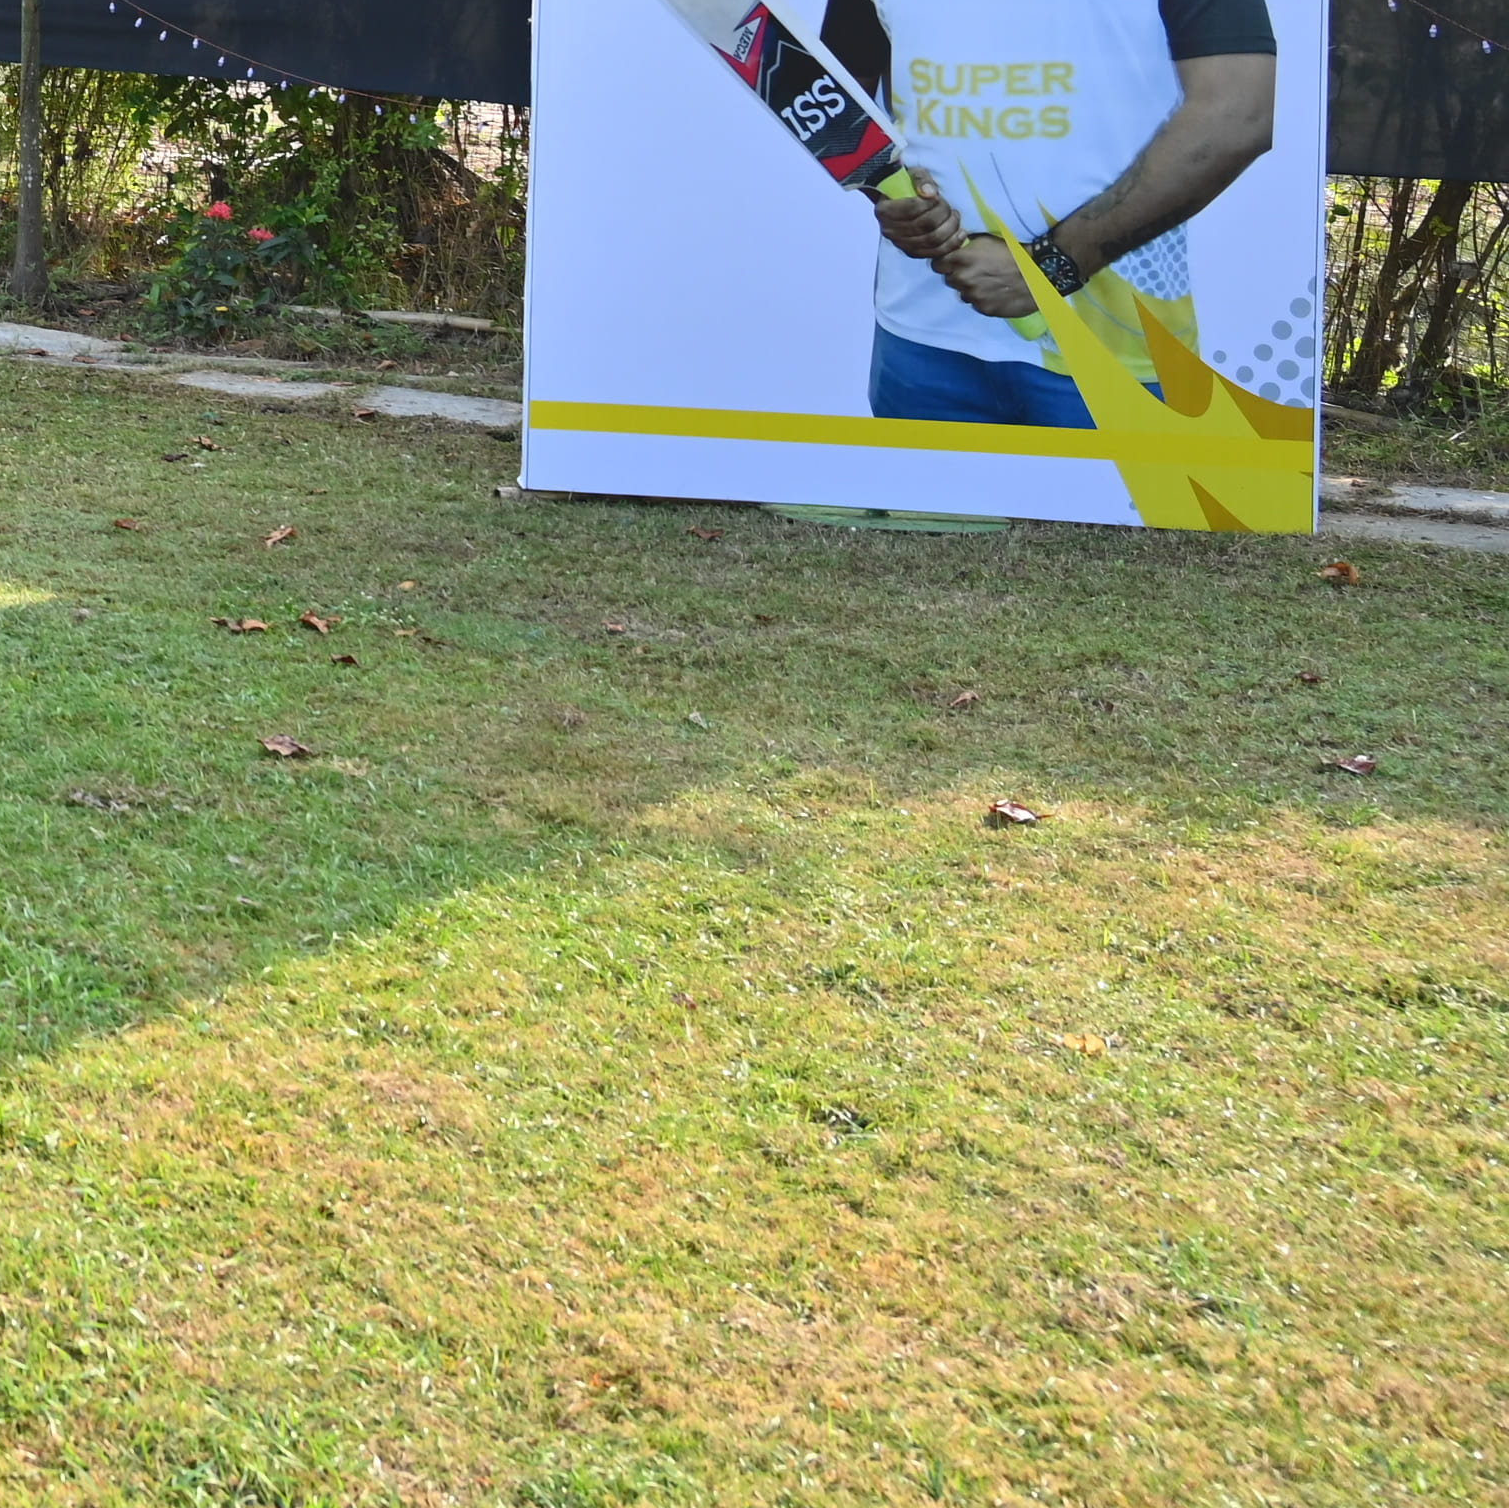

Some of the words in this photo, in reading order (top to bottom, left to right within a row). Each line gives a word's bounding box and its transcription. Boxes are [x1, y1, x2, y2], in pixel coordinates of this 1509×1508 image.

[909, 58, 1076, 96] SUPER
[781, 74, 845, 141] ISS
[917, 98, 1072, 140] KINGS
